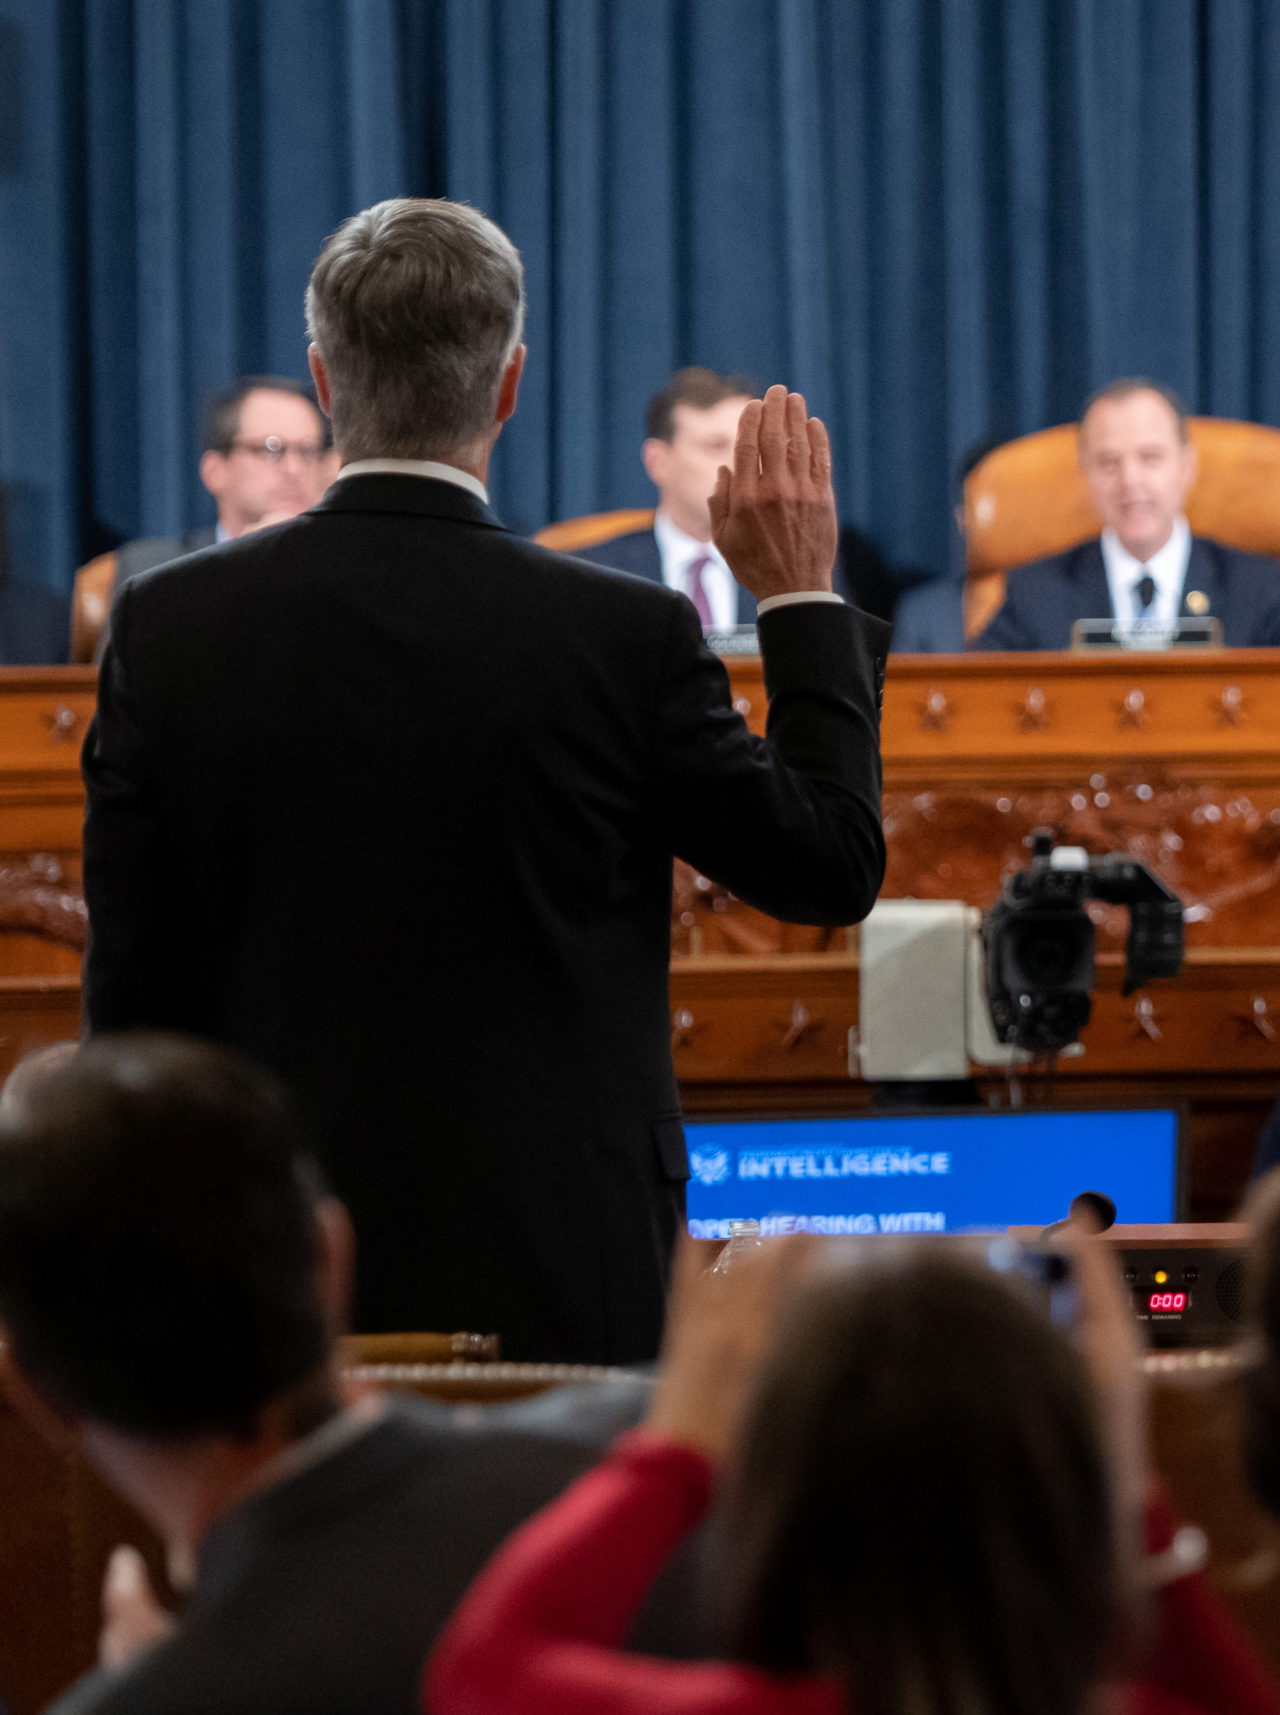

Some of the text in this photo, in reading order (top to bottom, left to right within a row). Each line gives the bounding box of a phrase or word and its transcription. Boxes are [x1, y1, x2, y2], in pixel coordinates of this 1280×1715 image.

[738, 1152, 951, 1180] INTELLIGENCE
[760, 1214, 878, 1237] HEARING
[879, 1212, 946, 1233] WITH
[1151, 1293, 1186, 1309] 0:00
